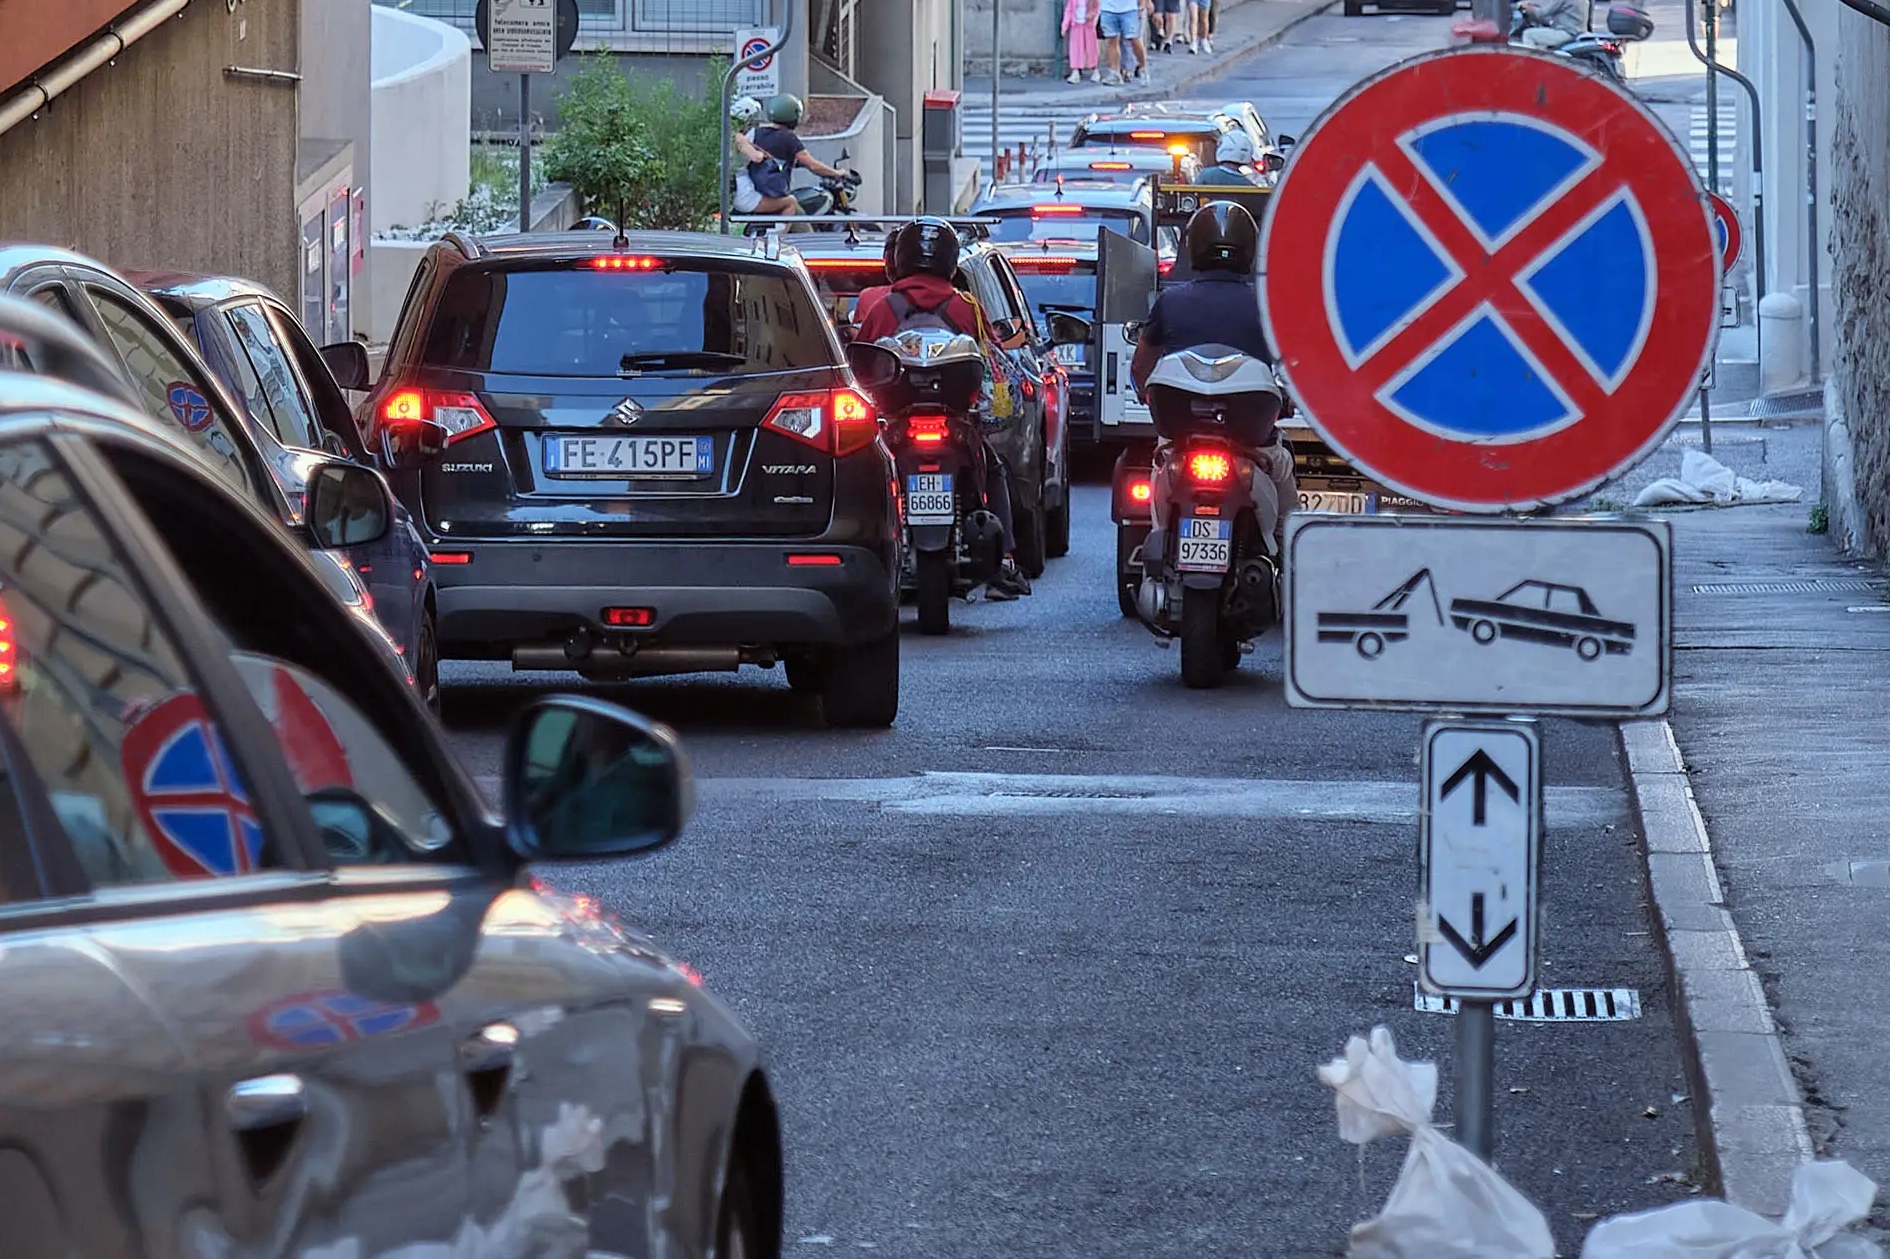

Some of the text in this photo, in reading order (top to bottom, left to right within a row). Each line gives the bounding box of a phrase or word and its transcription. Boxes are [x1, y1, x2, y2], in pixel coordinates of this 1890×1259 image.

[442, 463, 493, 472] SUZUKI
[762, 465, 816, 474] VITARA
[911, 495, 950, 510] 66866
[1193, 521, 1211, 537] DS
[1182, 542, 1227, 560] 97336
